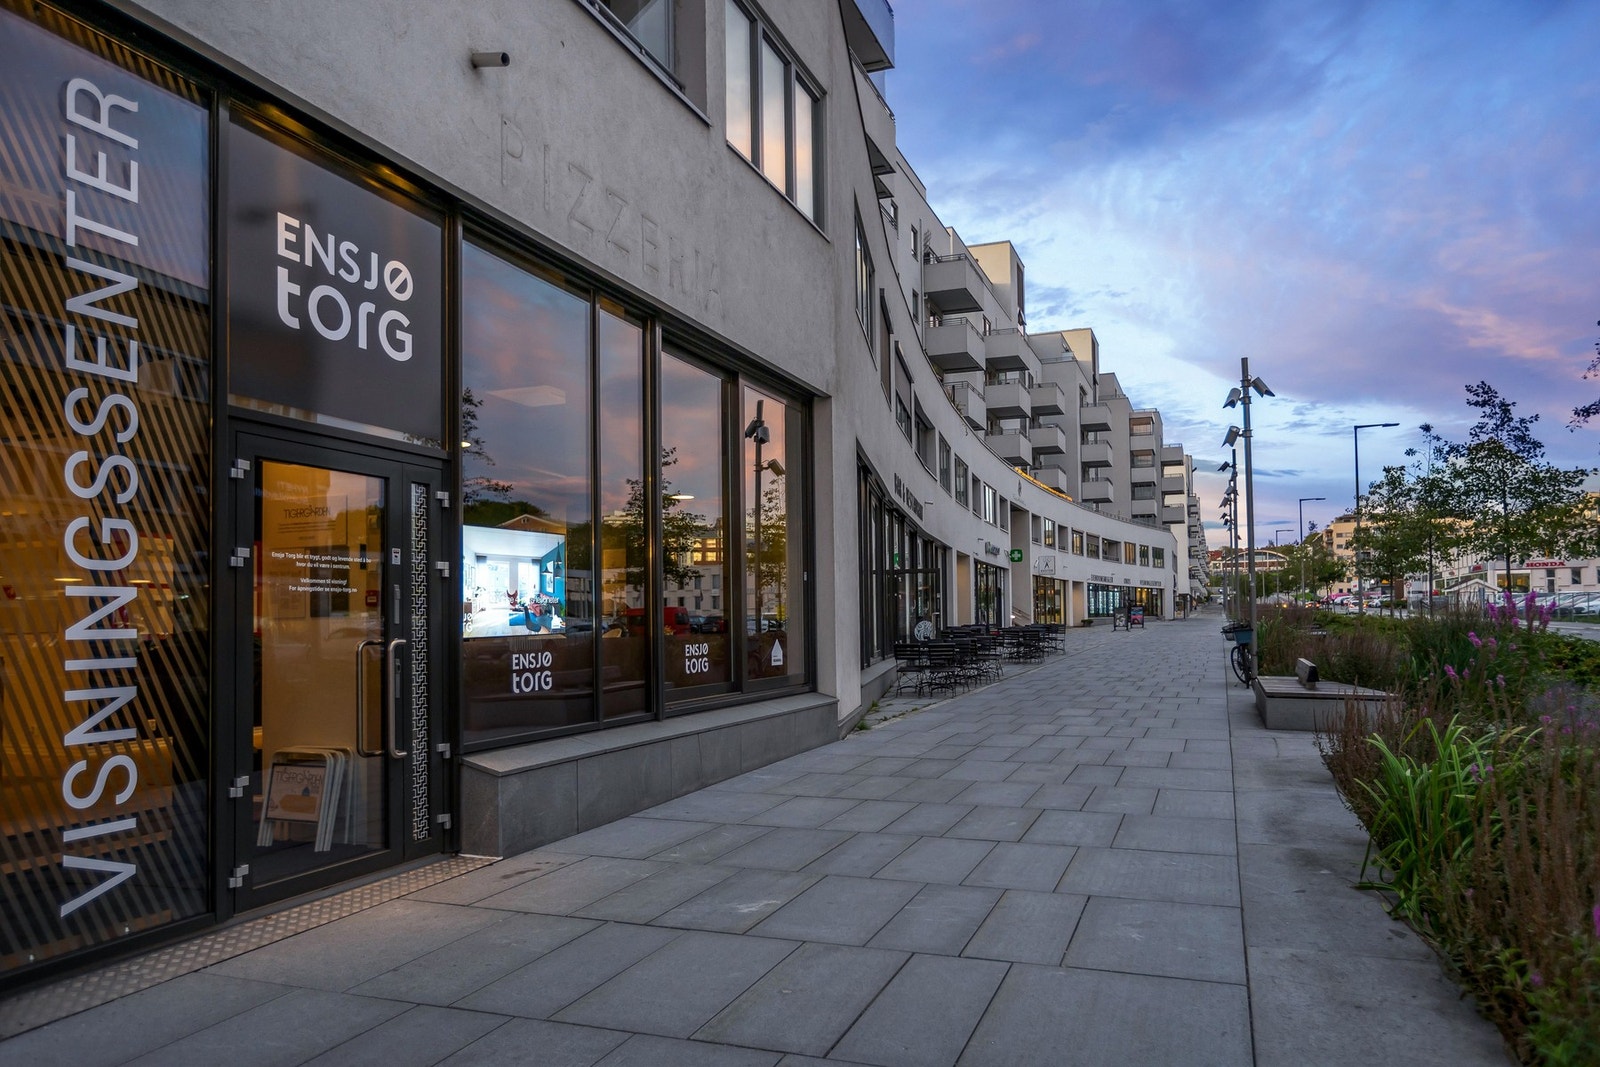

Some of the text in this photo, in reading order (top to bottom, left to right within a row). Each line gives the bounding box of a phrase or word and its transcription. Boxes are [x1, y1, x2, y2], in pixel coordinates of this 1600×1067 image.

[277, 212, 414, 302] ENSJØ
[60, 77, 139, 918] VISNINGSSENTER
[512, 651, 552, 671] ENSJØ
[685, 643, 709, 658] ENSJØ
